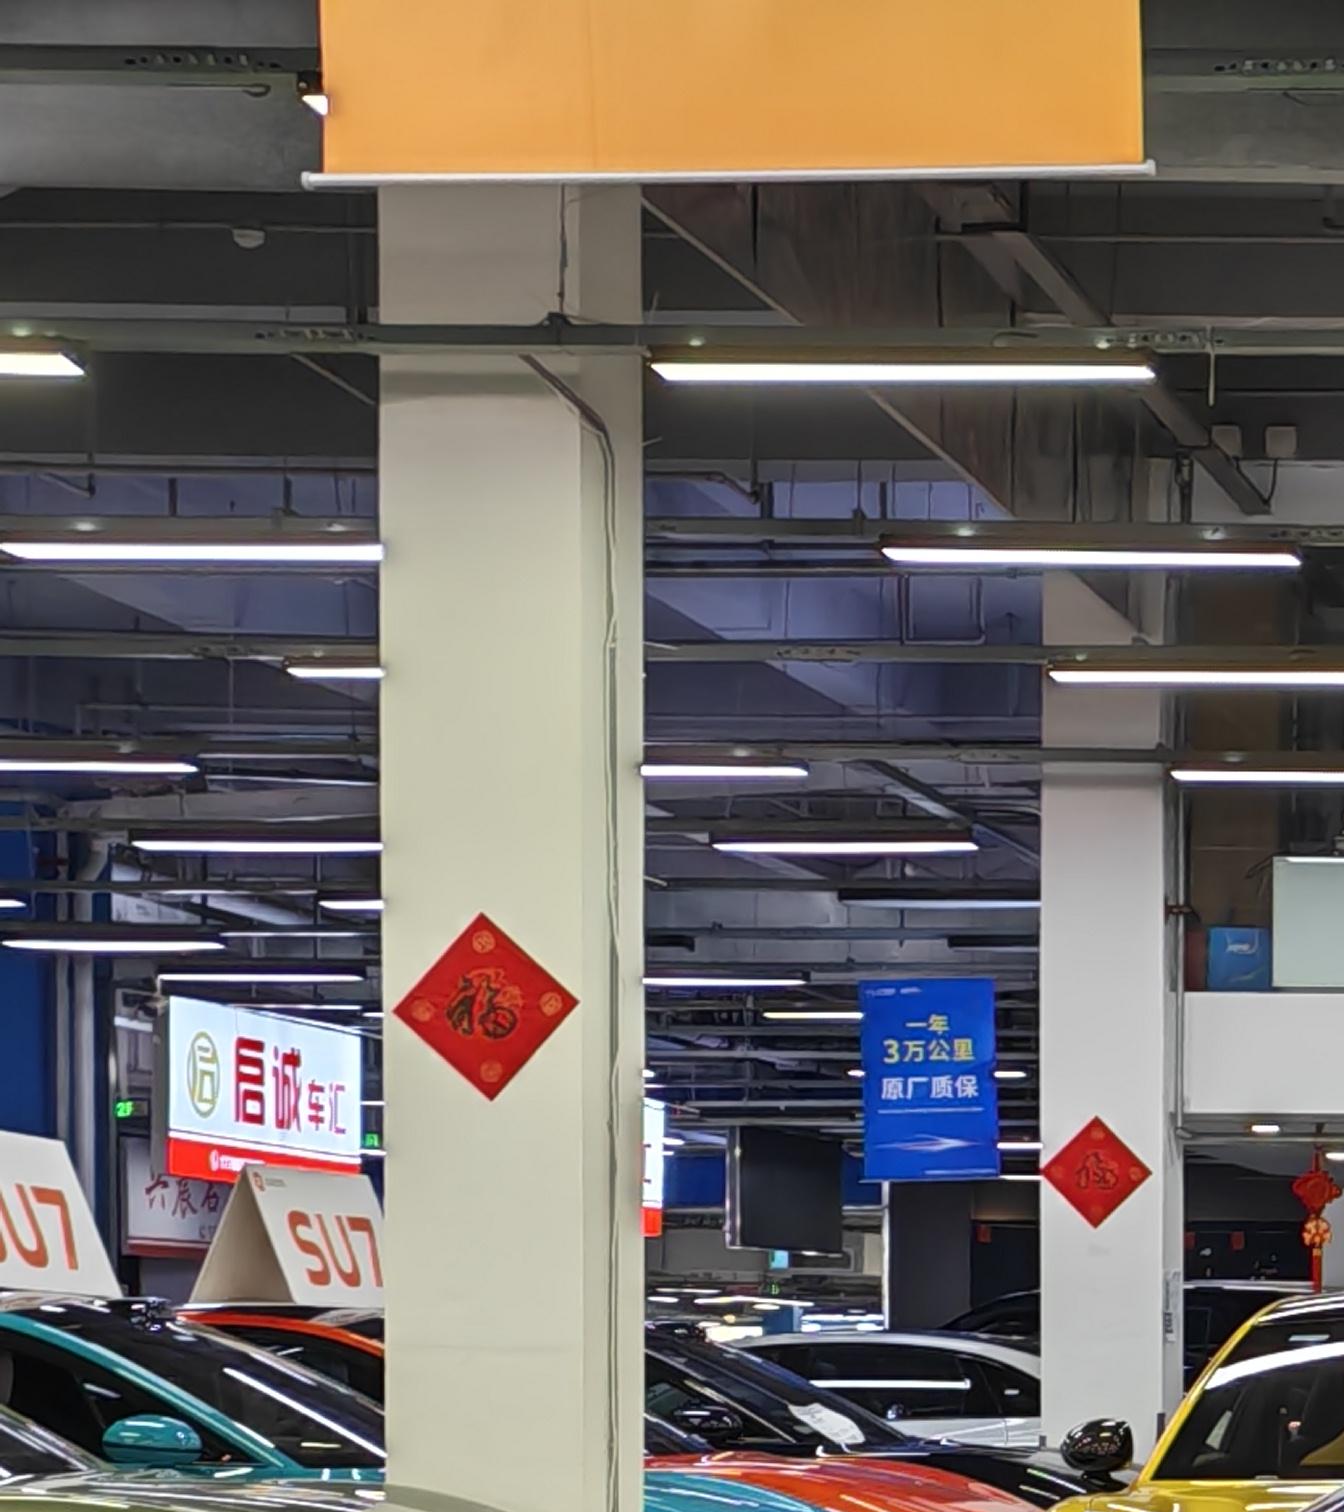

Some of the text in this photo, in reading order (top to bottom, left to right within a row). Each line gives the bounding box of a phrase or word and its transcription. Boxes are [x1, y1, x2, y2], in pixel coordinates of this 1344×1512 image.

[905, 1014, 950, 1034] 一年
[882, 1038, 975, 1064] 3万公里
[881, 1074, 979, 1100] 原厂质保
[0, 1183, 79, 1271] U7
[287, 1209, 384, 1288] SU7
